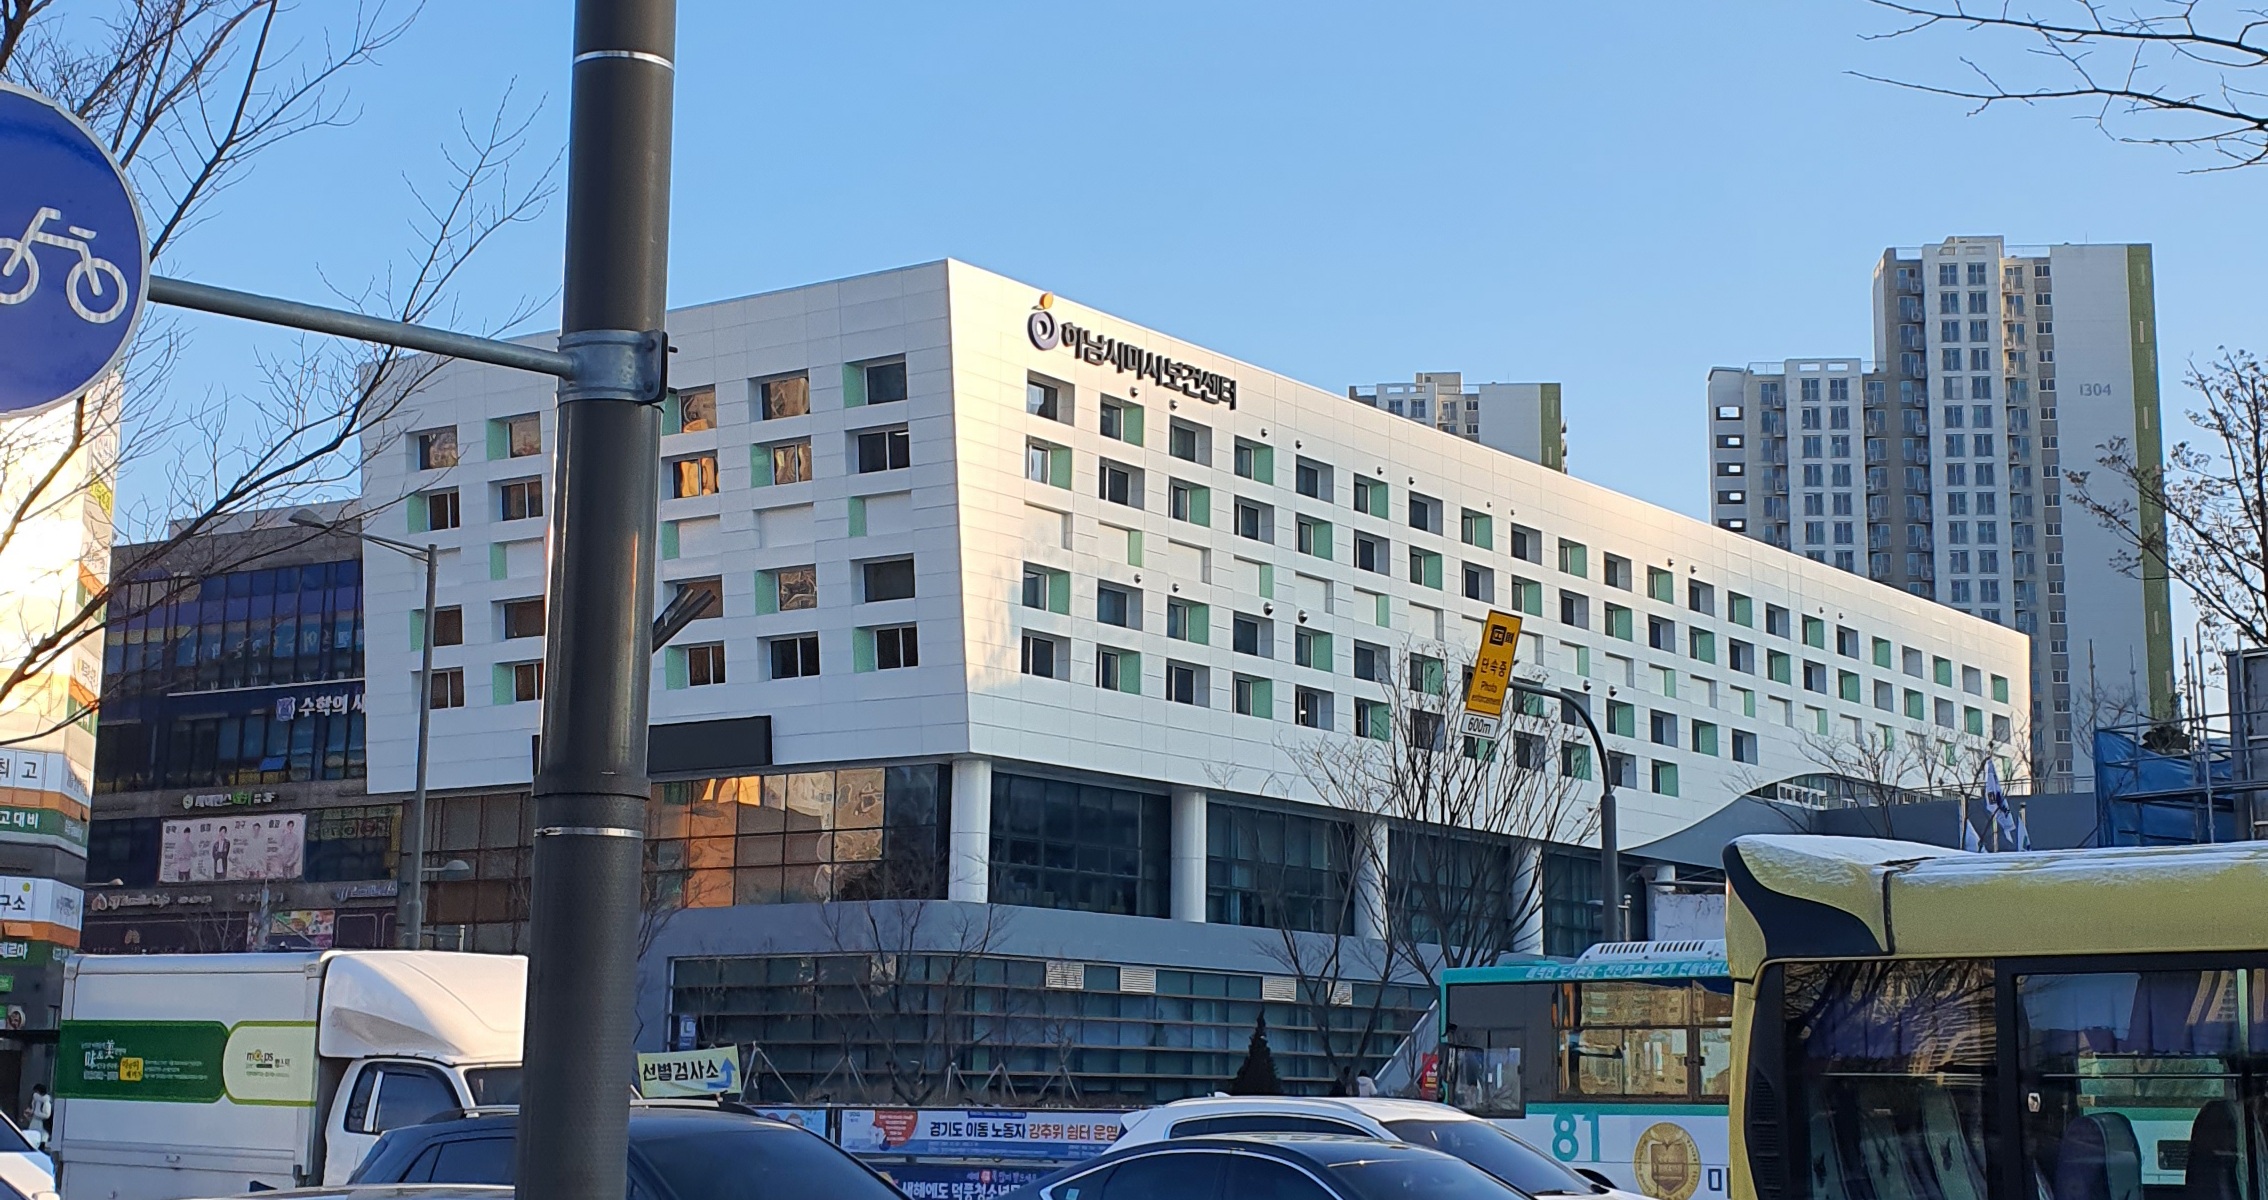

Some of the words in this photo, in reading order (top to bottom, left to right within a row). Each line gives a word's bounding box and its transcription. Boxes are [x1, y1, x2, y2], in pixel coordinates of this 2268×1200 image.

[2079, 382, 2112, 396] 1304
[1481, 657, 1507, 678] 단속중
[298, 694, 348, 718] 수학의
[1467, 717, 1491, 734] 600m
[643, 1059, 719, 1082] 선별검사소
[930, 1121, 964, 1139] 경기도
[966, 1122, 988, 1139] 이동
[991, 1122, 1026, 1140] 노동자
[1028, 1122, 1064, 1140] 강추위
[1067, 1123, 1090, 1141] 쉼터
[1093, 1124, 1118, 1141] 운영
[1552, 1111, 1600, 1162] 81
[902, 1182, 949, 1199] 새해에도
[951, 1183, 1021, 1200] 덕풍청소년
